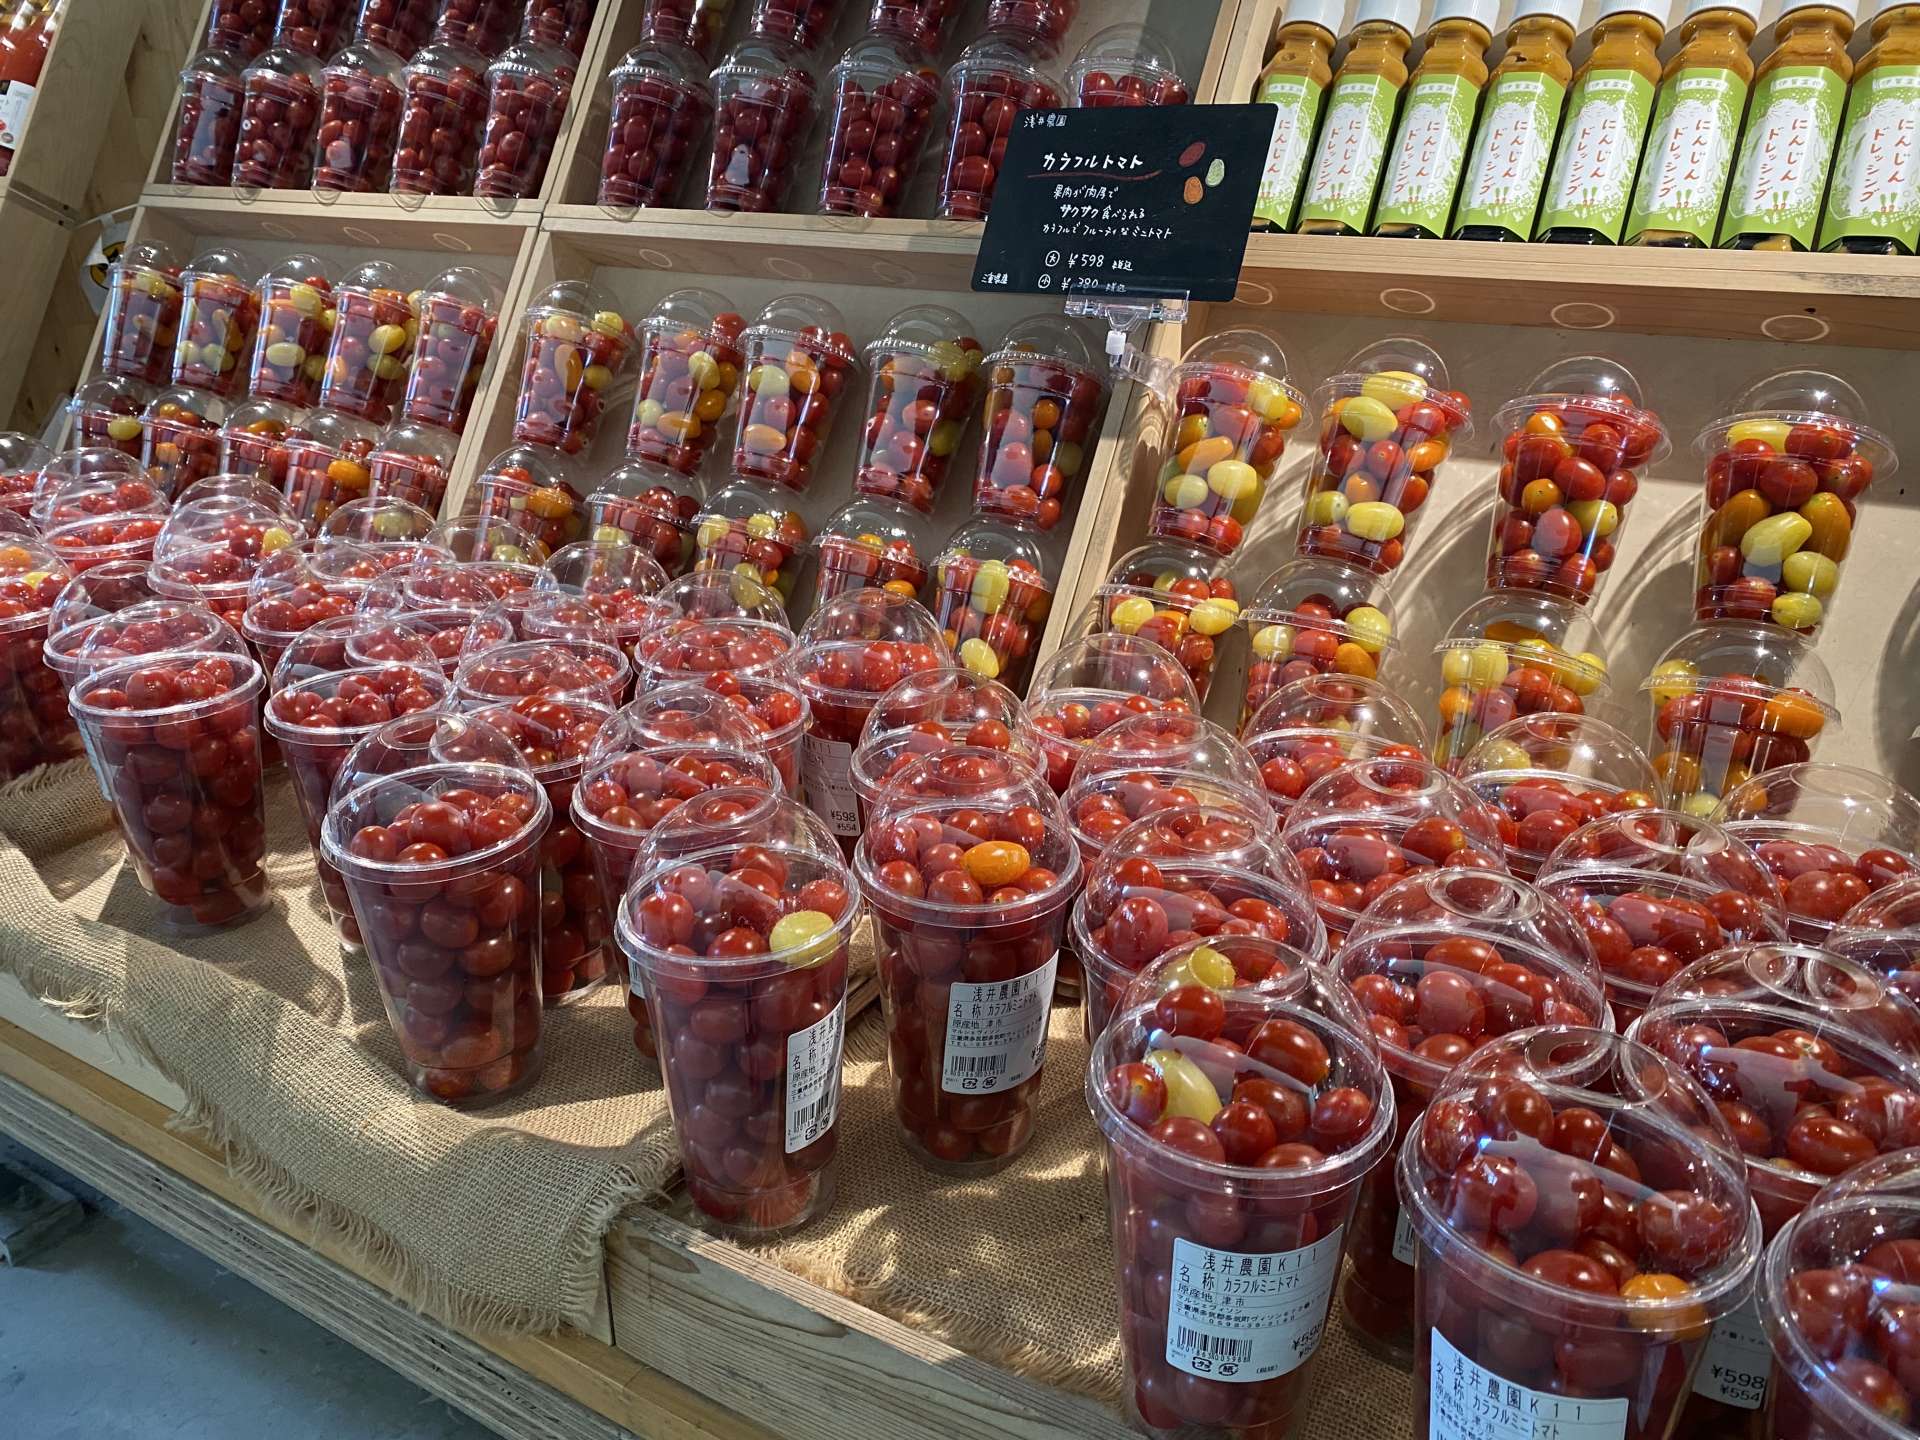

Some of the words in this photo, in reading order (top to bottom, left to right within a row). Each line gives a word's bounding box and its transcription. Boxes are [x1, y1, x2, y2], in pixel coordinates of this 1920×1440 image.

[1042, 152, 1143, 171] カラフルトマト
[1267, 120, 1290, 173] にんじん
[1316, 127, 1343, 191] ドレッシング
[1338, 120, 1361, 175] にんじん
[1394, 129, 1420, 193] ドレッシング
[1416, 121, 1440, 177] にんじん
[1479, 127, 1507, 195] ドレッシング
[1503, 120, 1528, 178] にんじん
[1566, 126, 1595, 196] ドレッシング
[1590, 119, 1616, 178] にんじん
[1658, 126, 1688, 198] ドレッシング
[1684, 118, 1711, 181] にんじん
[1754, 127, 1785, 200] ドレッシング
[1780, 118, 1808, 182] にんじん
[1860, 127, 1890, 202] ドレッシング
[1888, 118, 1914, 183] にんじん
[1053, 184, 1119, 200] 果肉が肉厚で
[831, 809, 856, 821] ¥598
[988, 991, 1037, 1016] カラフルミニトマト
[1180, 1264, 1214, 1291] 名称
[1223, 1274, 1300, 1294] カラフルミニトマト
[1711, 1364, 1764, 1389] ¥598
[1721, 1384, 1760, 1402] ¥554
[1473, 1393, 1559, 1440] カラフルミニトマト
